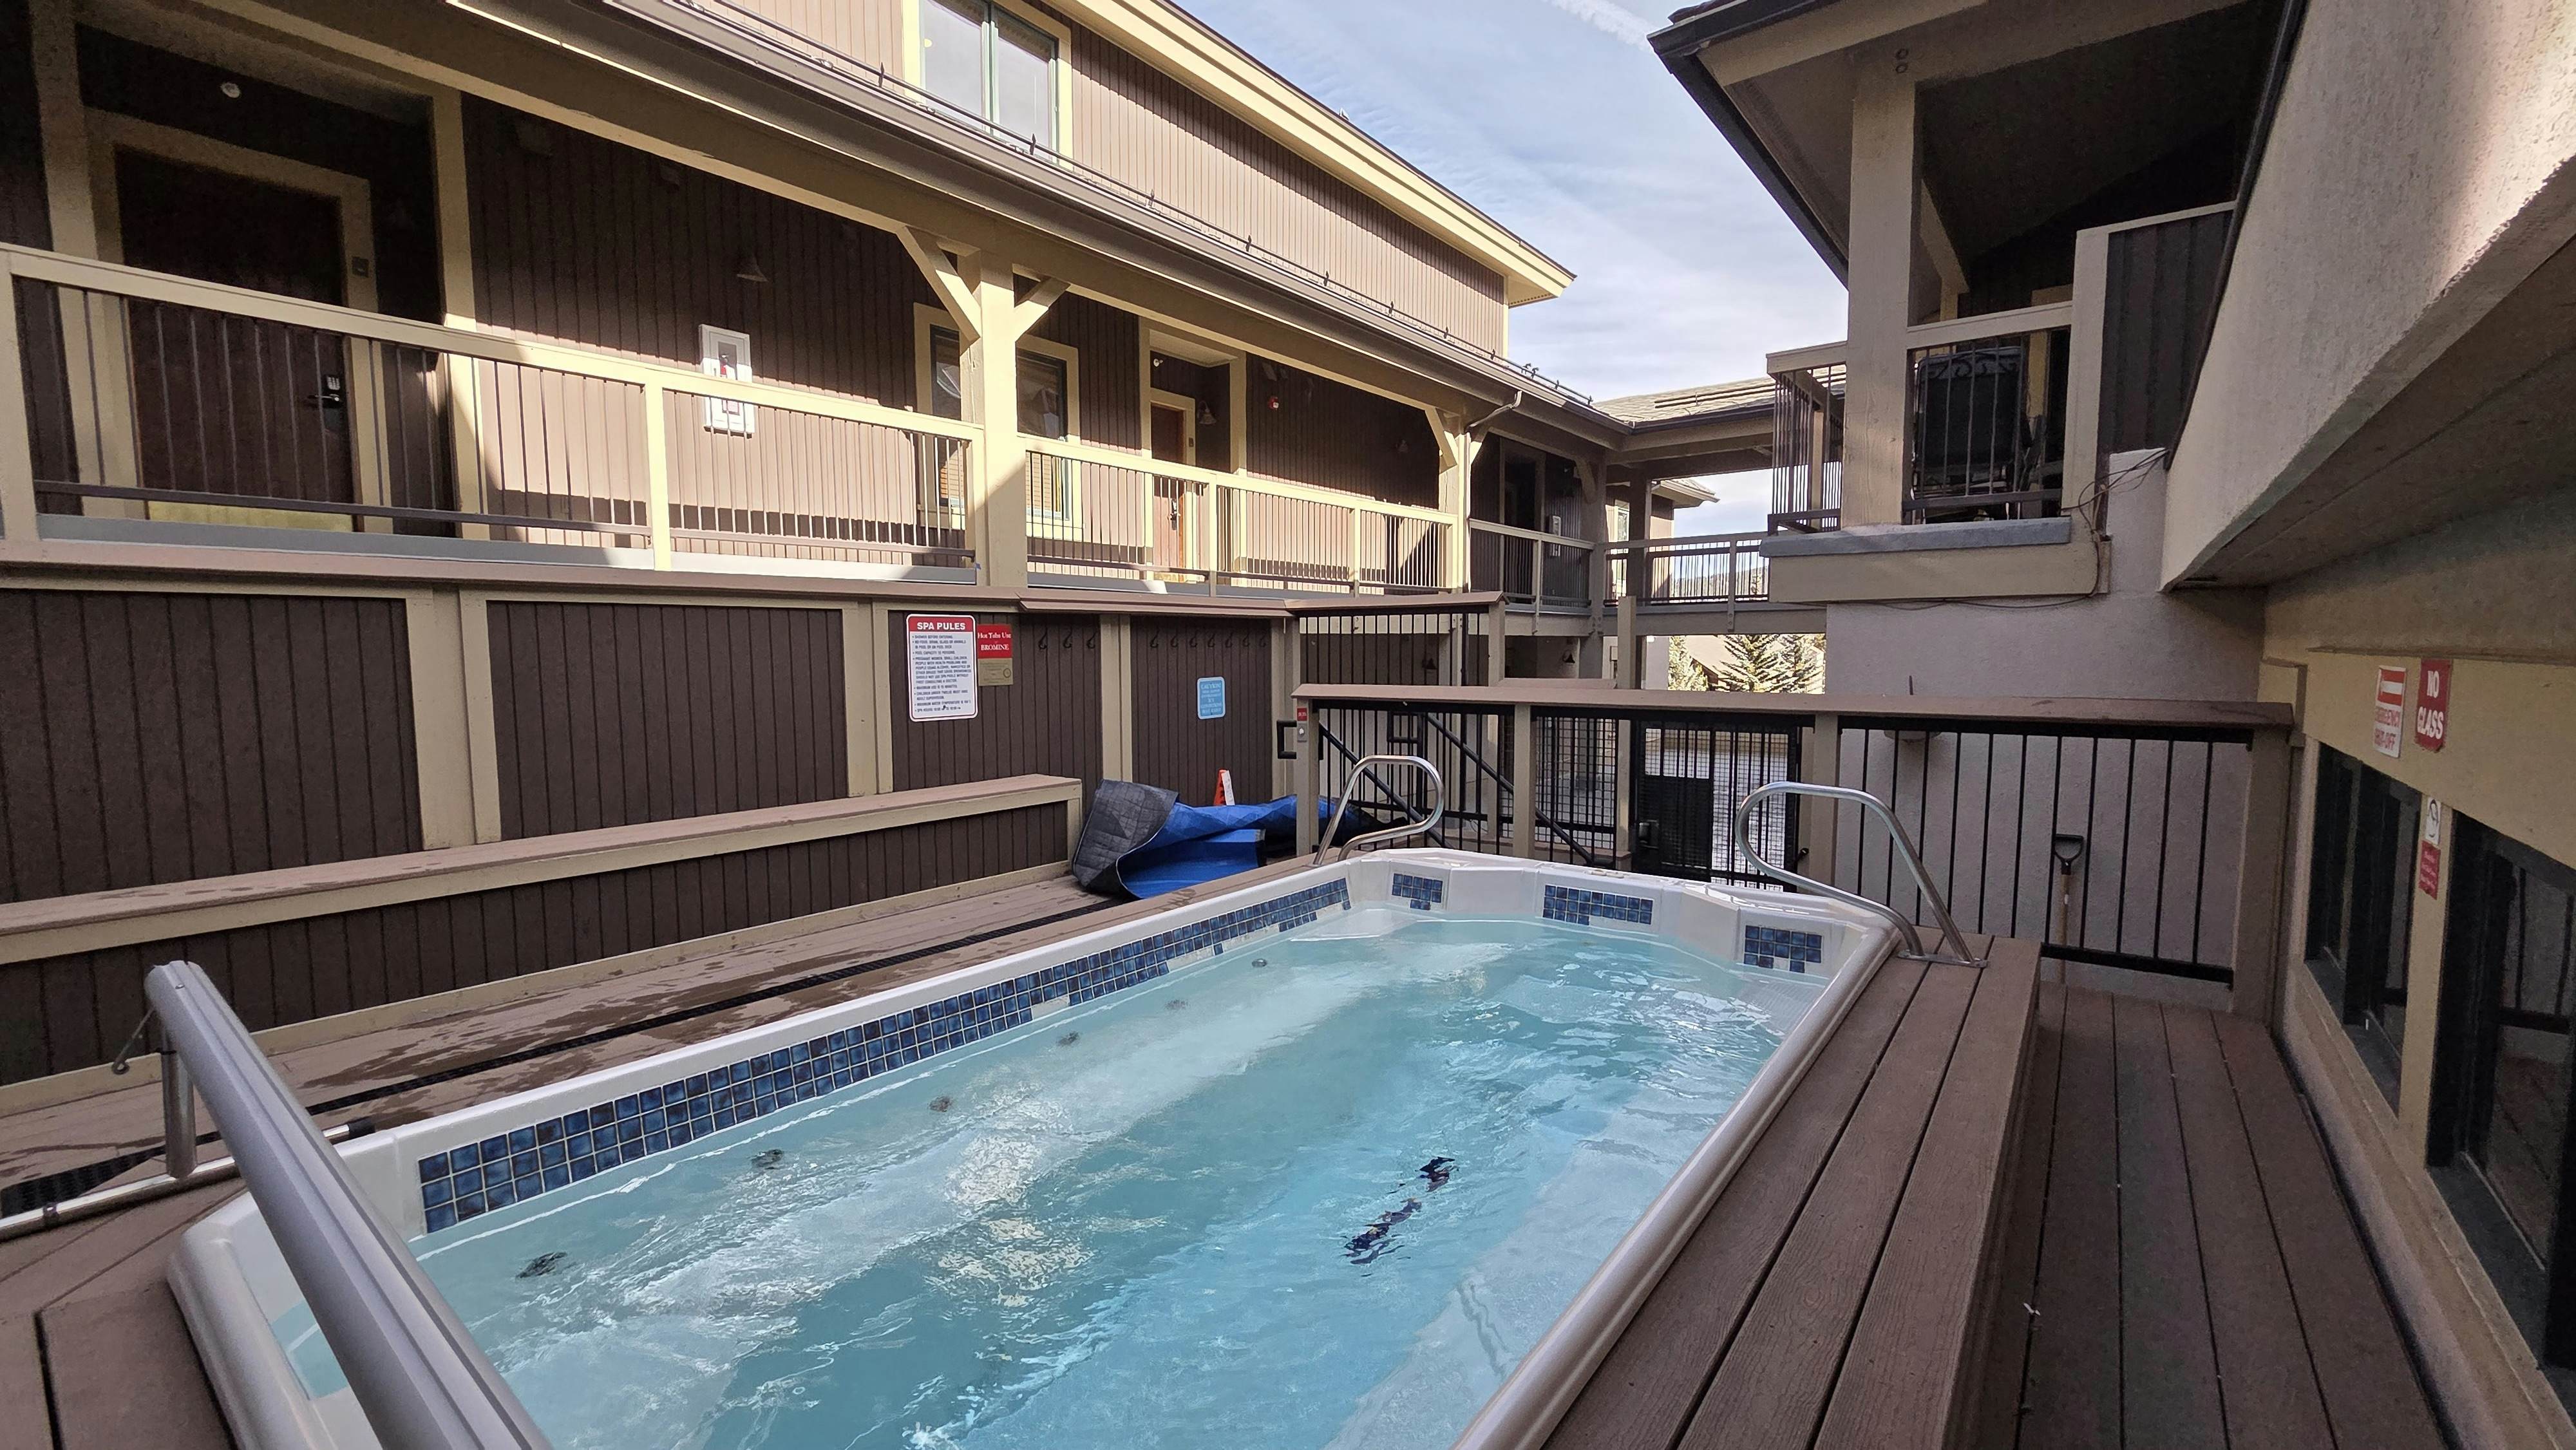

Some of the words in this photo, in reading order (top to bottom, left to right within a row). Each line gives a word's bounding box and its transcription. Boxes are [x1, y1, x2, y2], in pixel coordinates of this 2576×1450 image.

[916, 622, 934, 630] SPA
[2426, 670, 2439, 699] NO
[2416, 706, 2444, 740] GLASS
